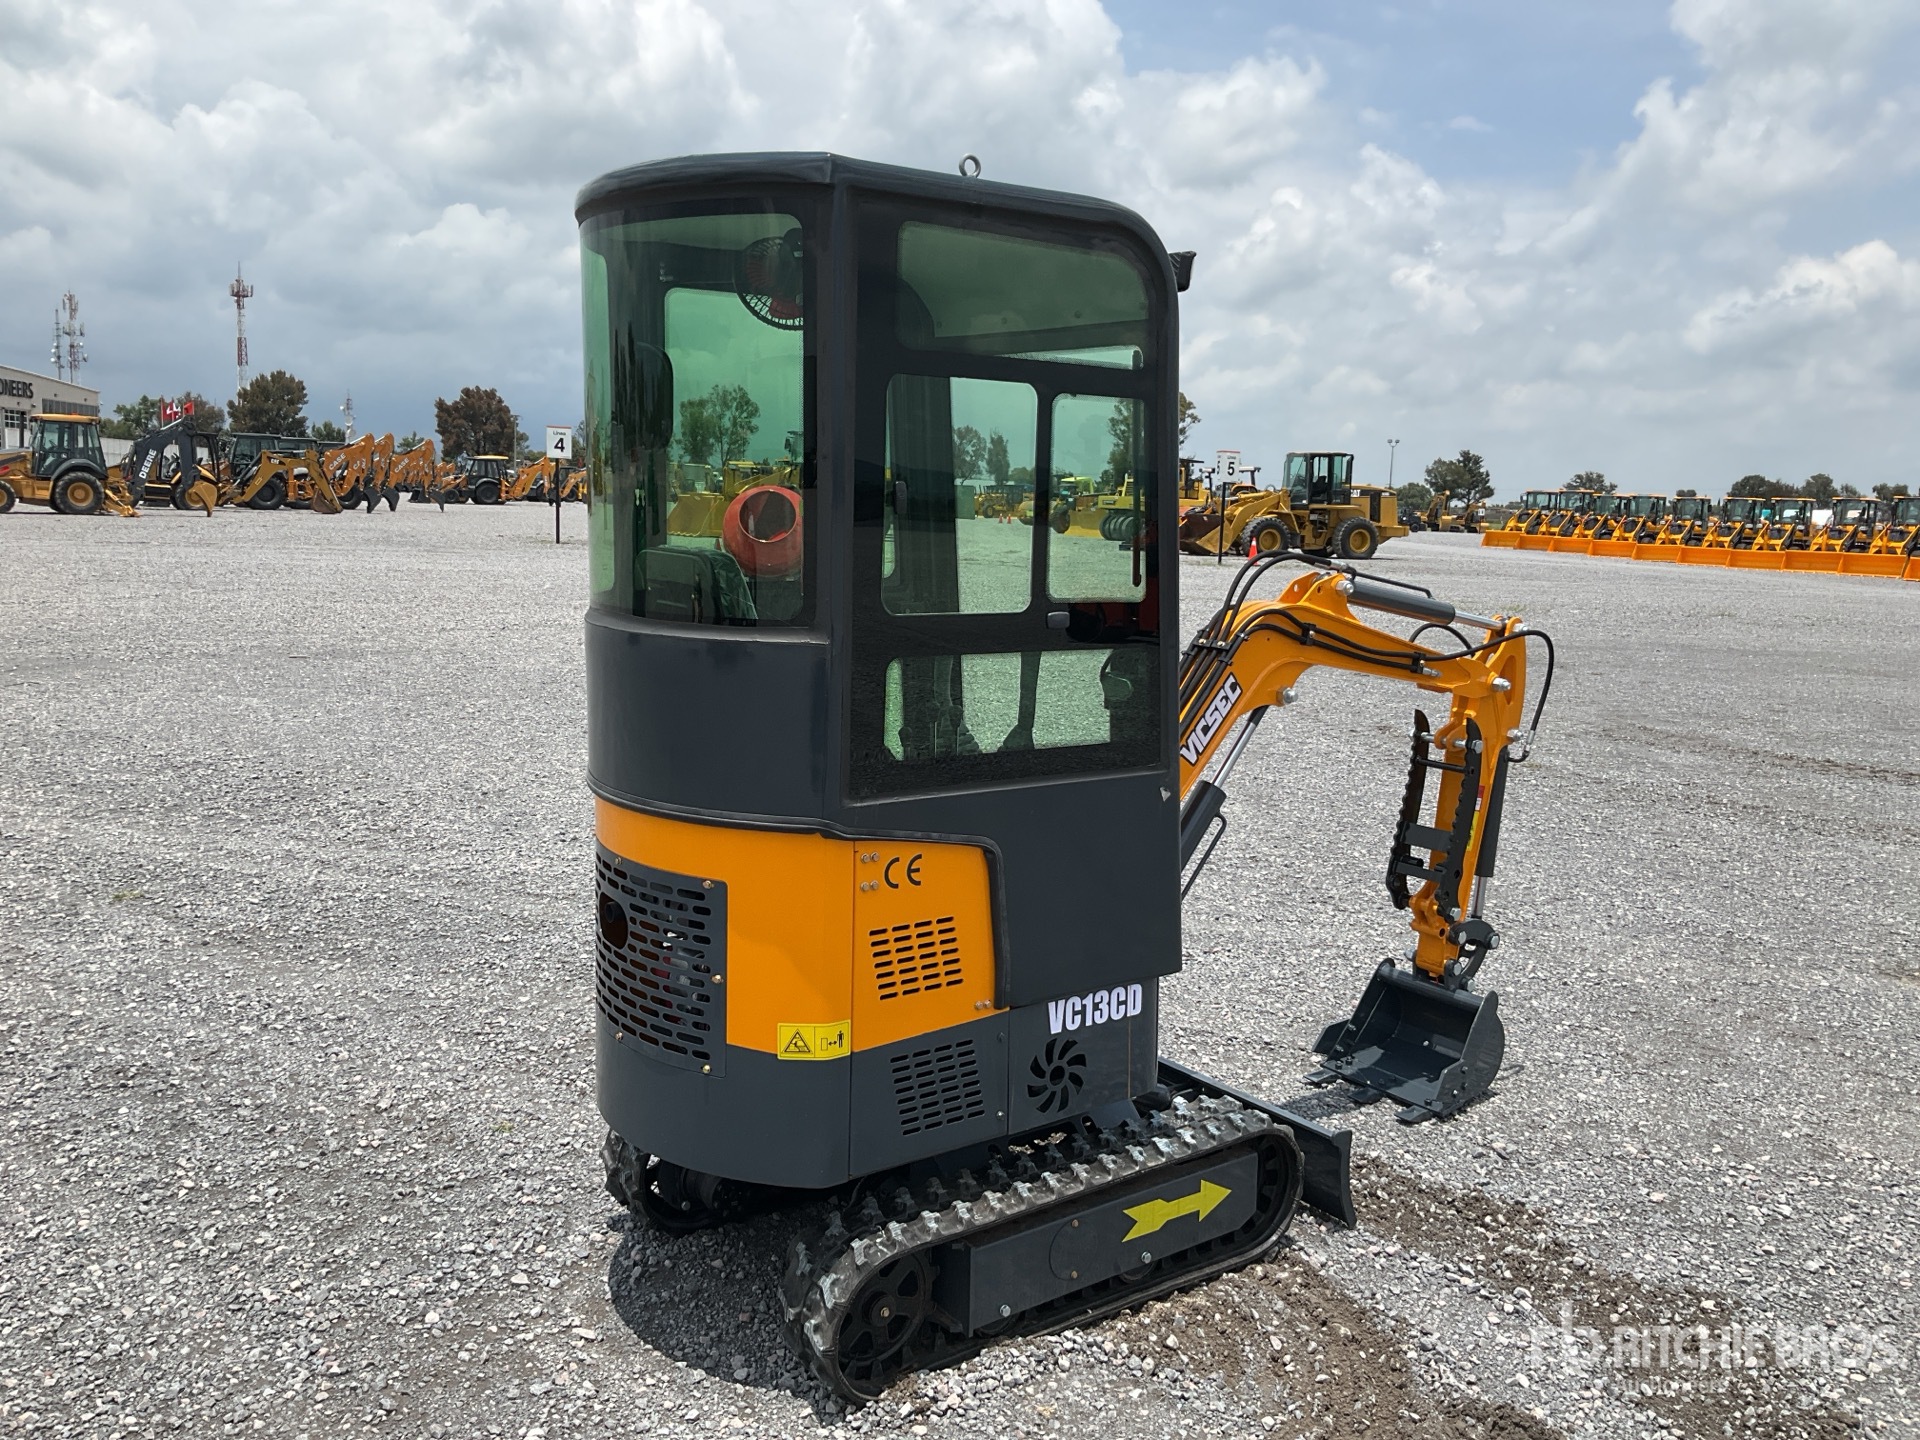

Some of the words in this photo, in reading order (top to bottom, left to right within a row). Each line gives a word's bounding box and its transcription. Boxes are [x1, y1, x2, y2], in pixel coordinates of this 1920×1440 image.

[554, 438, 565, 452] 4
[139, 448, 157, 479] DEERE
[329, 452, 346, 470] CASE
[1227, 461, 1235, 476] 5
[1180, 673, 1242, 765] VICSEC
[884, 853, 922, 889] CE
[1048, 983, 1142, 1034] VC13CD
